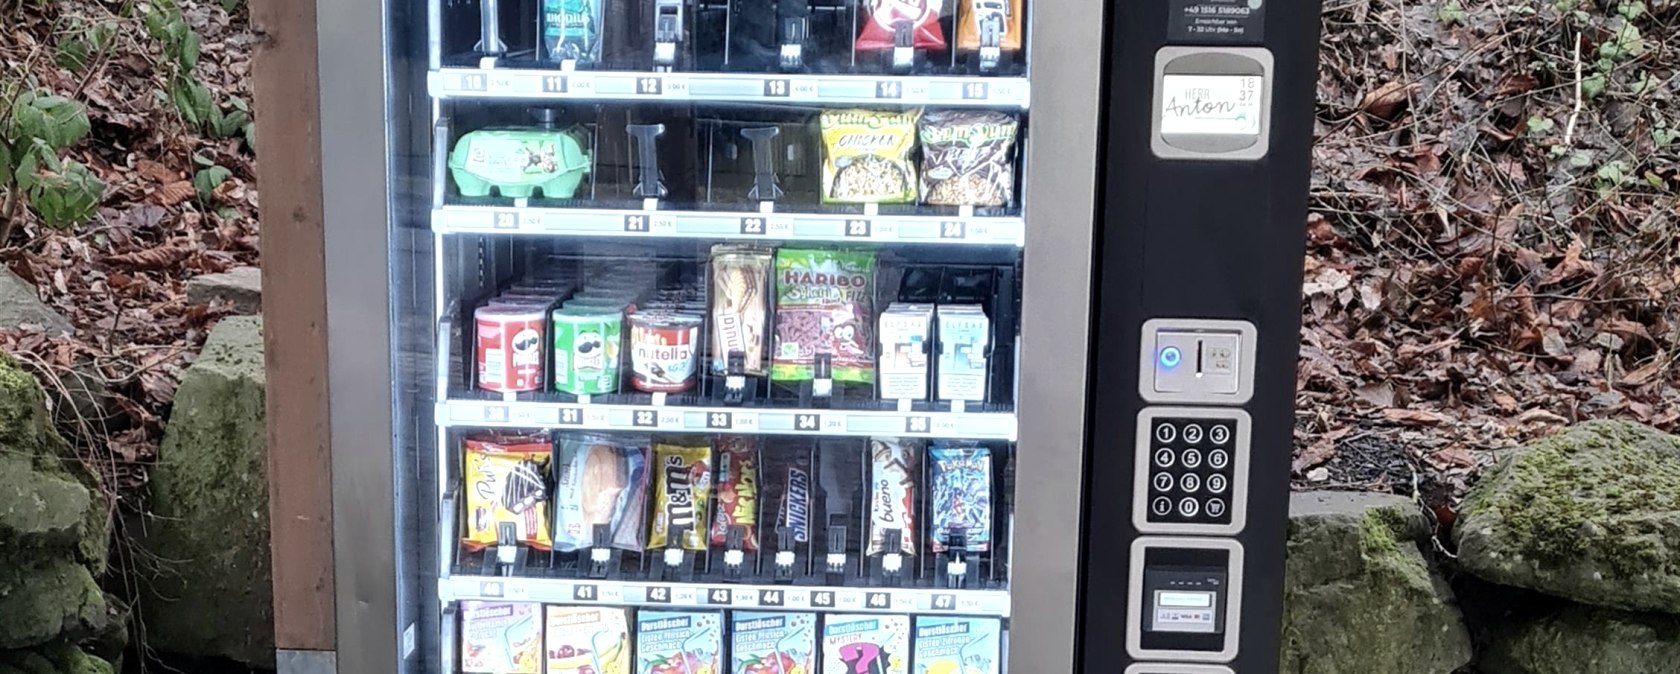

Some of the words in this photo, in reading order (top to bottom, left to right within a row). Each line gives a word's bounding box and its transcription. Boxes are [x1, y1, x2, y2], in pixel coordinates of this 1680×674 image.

[546, 77, 562, 91] 11
[641, 79, 656, 92] 12
[769, 80, 785, 94] 13
[880, 82, 897, 96] 14
[1240, 78, 1254, 88] 18
[966, 83, 983, 97] 15
[1240, 90, 1254, 101] 37
[1166, 96, 1236, 117] Anton
[628, 216, 644, 229] 21
[745, 219, 761, 232] 22
[850, 221, 866, 234] 23
[944, 223, 961, 237] 24
[784, 270, 866, 288] HARIBO
[722, 316, 738, 352] nuta
[639, 348, 687, 360] nutella
[562, 410, 577, 423] 31
[637, 412, 652, 424] 32
[711, 414, 726, 426] 33
[799, 415, 815, 429] 34
[1163, 427, 1168, 438] 1
[1188, 428, 1197, 439] 2
[1216, 429, 1224, 440] 3
[1160, 452, 1169, 463] 4
[1187, 452, 1195, 464] 5
[1214, 454, 1222, 464] 6
[1160, 476, 1168, 487] 7
[1186, 477, 1194, 488] 8
[1212, 478, 1221, 489] 9
[788, 470, 808, 541] SNICKERS
[879, 480, 894, 522] bueno
[1184, 501, 1192, 512] 0
[577, 586, 592, 598] 41
[650, 588, 666, 600] 42
[712, 590, 728, 602] 43
[763, 591, 779, 604] 44
[814, 592, 830, 605] 45
[870, 593, 886, 606] 46
[935, 595, 951, 608] 47
[641, 618, 689, 631] Durstlöscher
[736, 619, 783, 631] Durstlöscher
